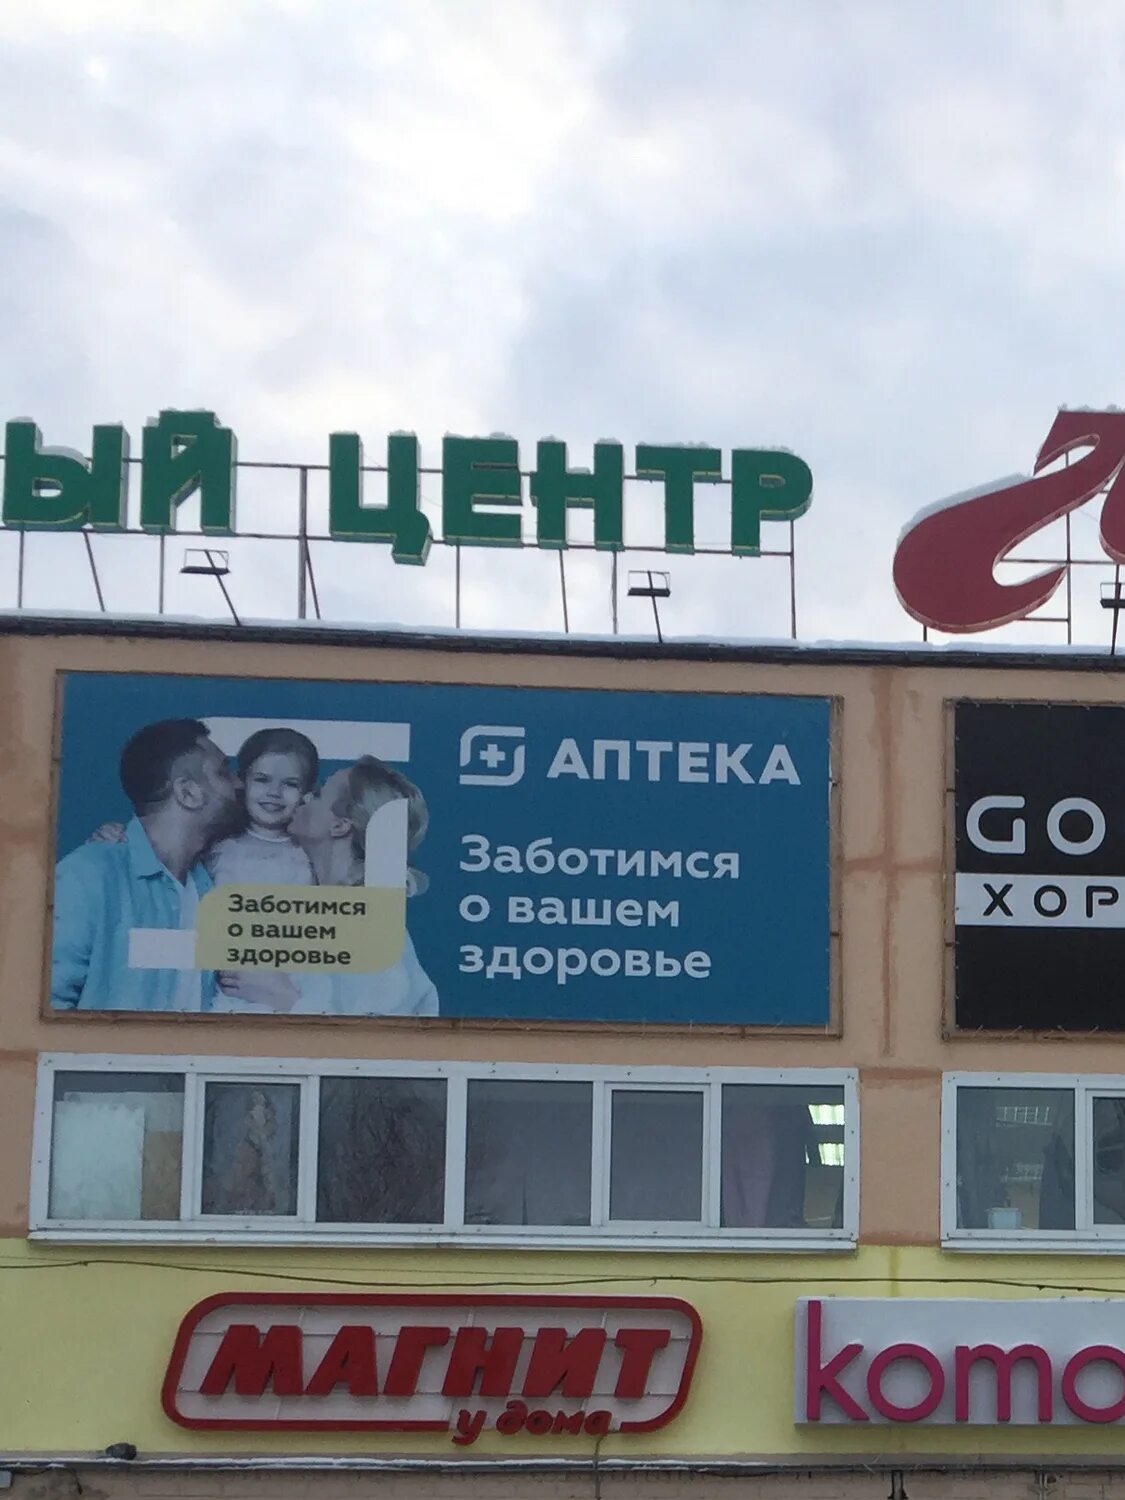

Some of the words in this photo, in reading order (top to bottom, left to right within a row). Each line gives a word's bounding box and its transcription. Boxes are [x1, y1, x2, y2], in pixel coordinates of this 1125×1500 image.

[330, 433, 813, 565] ЦЕНТР
[546, 738, 801, 786] АПТЕКА
[459, 834, 740, 881] Заботимся
[228, 893, 367, 918] Заботимся
[459, 894, 490, 923] о
[508, 896, 680, 928] вашем
[227, 923, 244, 938] о
[251, 923, 336, 941] вашем
[226, 947, 352, 969] здоровье
[458, 945, 712, 985] здоровье
[200, 1324, 671, 1399] МАГНИТ
[451, 1408, 487, 1446] у
[494, 1401, 612, 1436] дома
